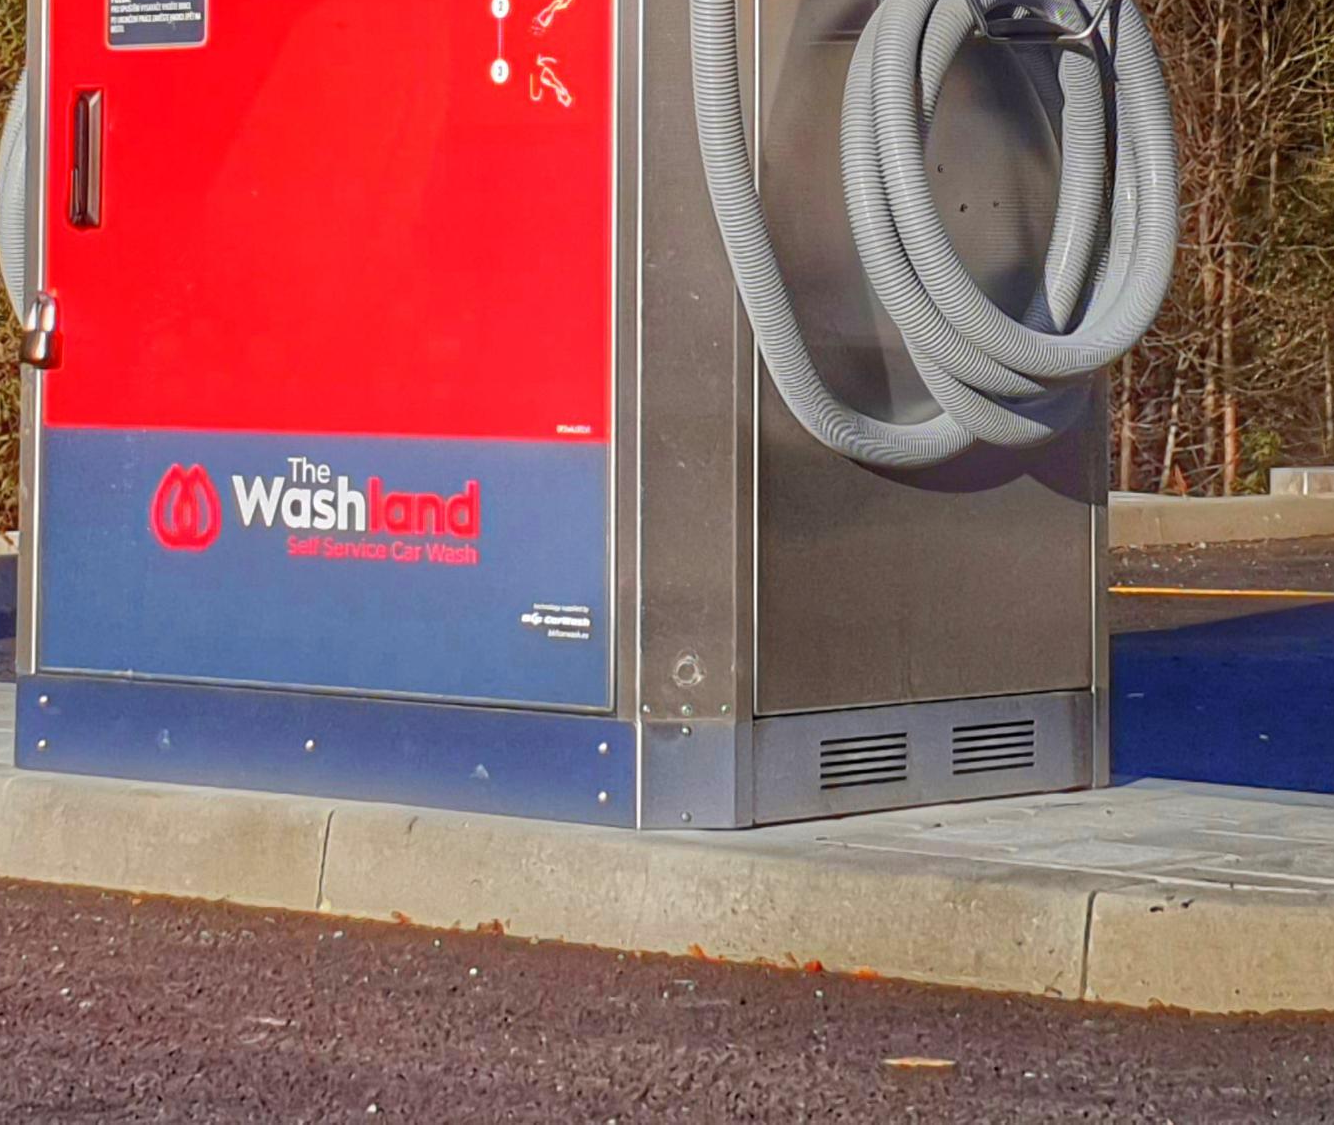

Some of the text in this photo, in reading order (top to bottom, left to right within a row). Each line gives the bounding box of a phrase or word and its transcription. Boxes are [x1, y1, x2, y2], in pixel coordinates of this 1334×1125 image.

[287, 457, 331, 483] The
[232, 475, 480, 539] Washland
[324, 538, 387, 560] Service
[391, 541, 422, 562] Car
[427, 544, 478, 566] Wash
